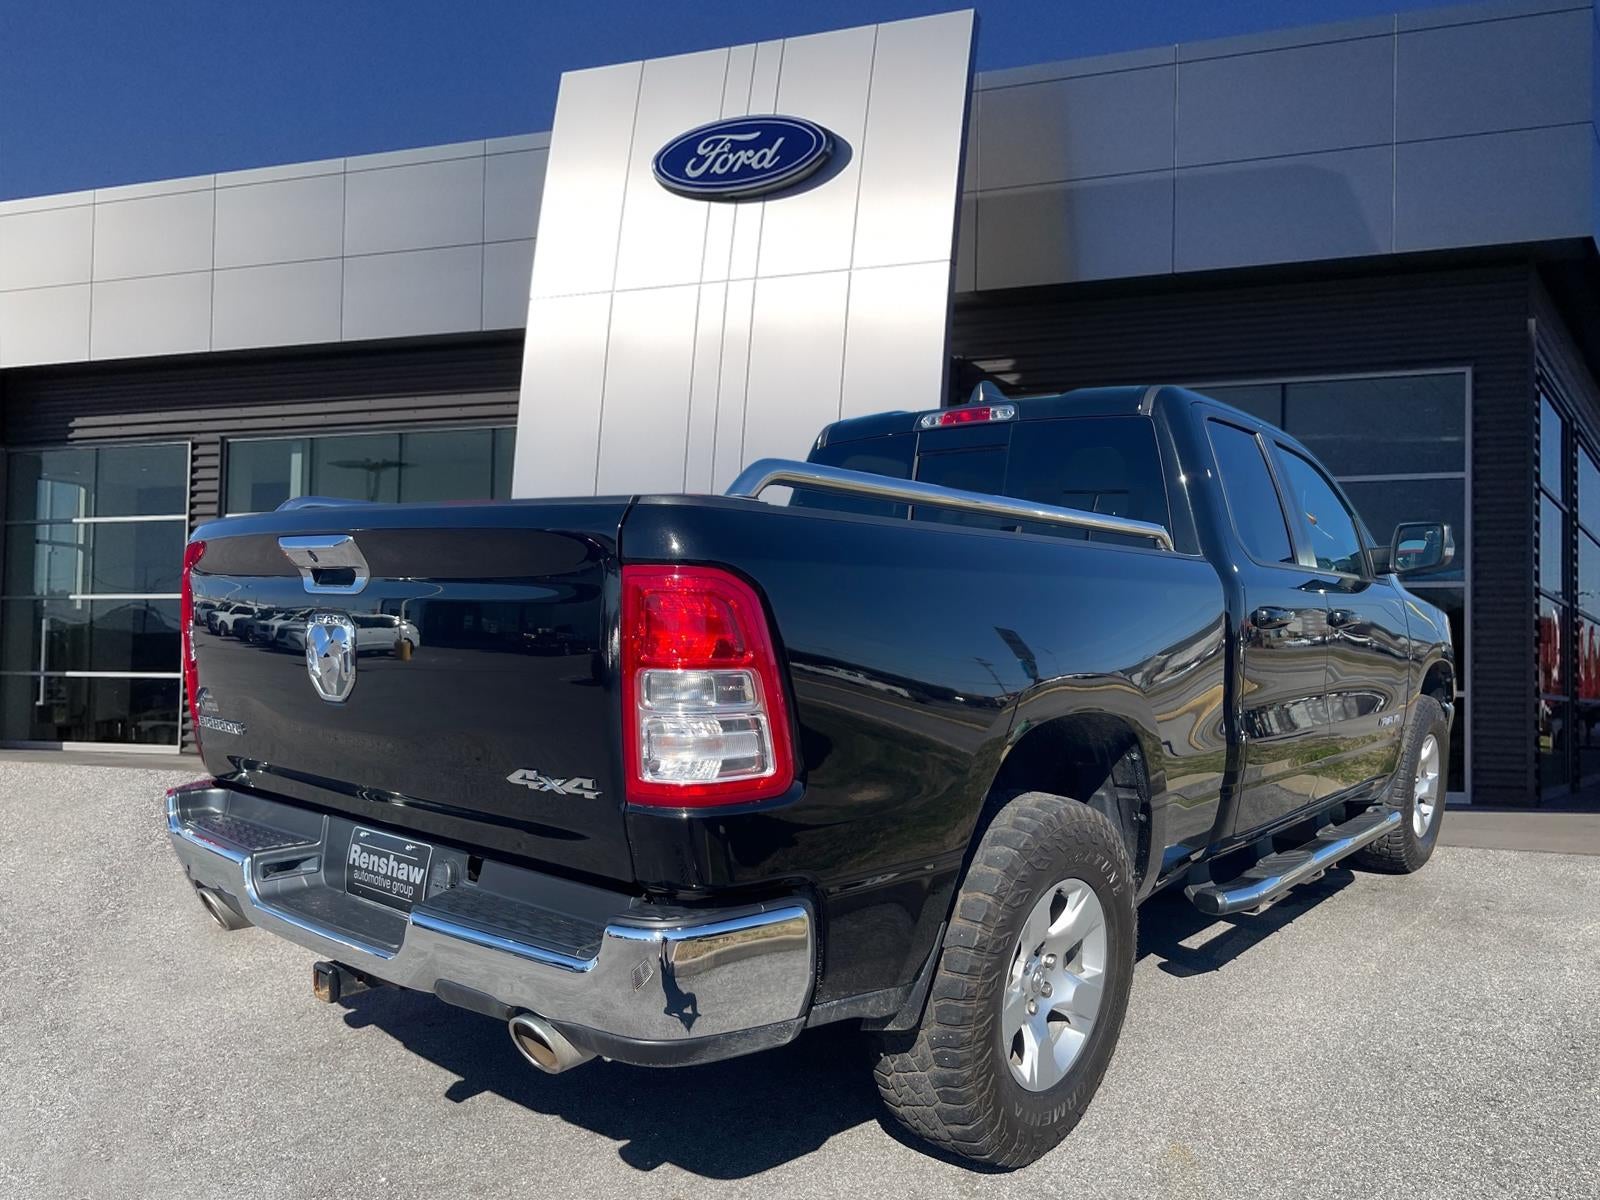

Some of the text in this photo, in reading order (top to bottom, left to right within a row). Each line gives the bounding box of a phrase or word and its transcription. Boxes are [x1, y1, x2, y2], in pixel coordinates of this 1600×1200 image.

[685, 131, 785, 178] Ford
[348, 843, 425, 885] Renshaw
[353, 869, 414, 898] automotive group
